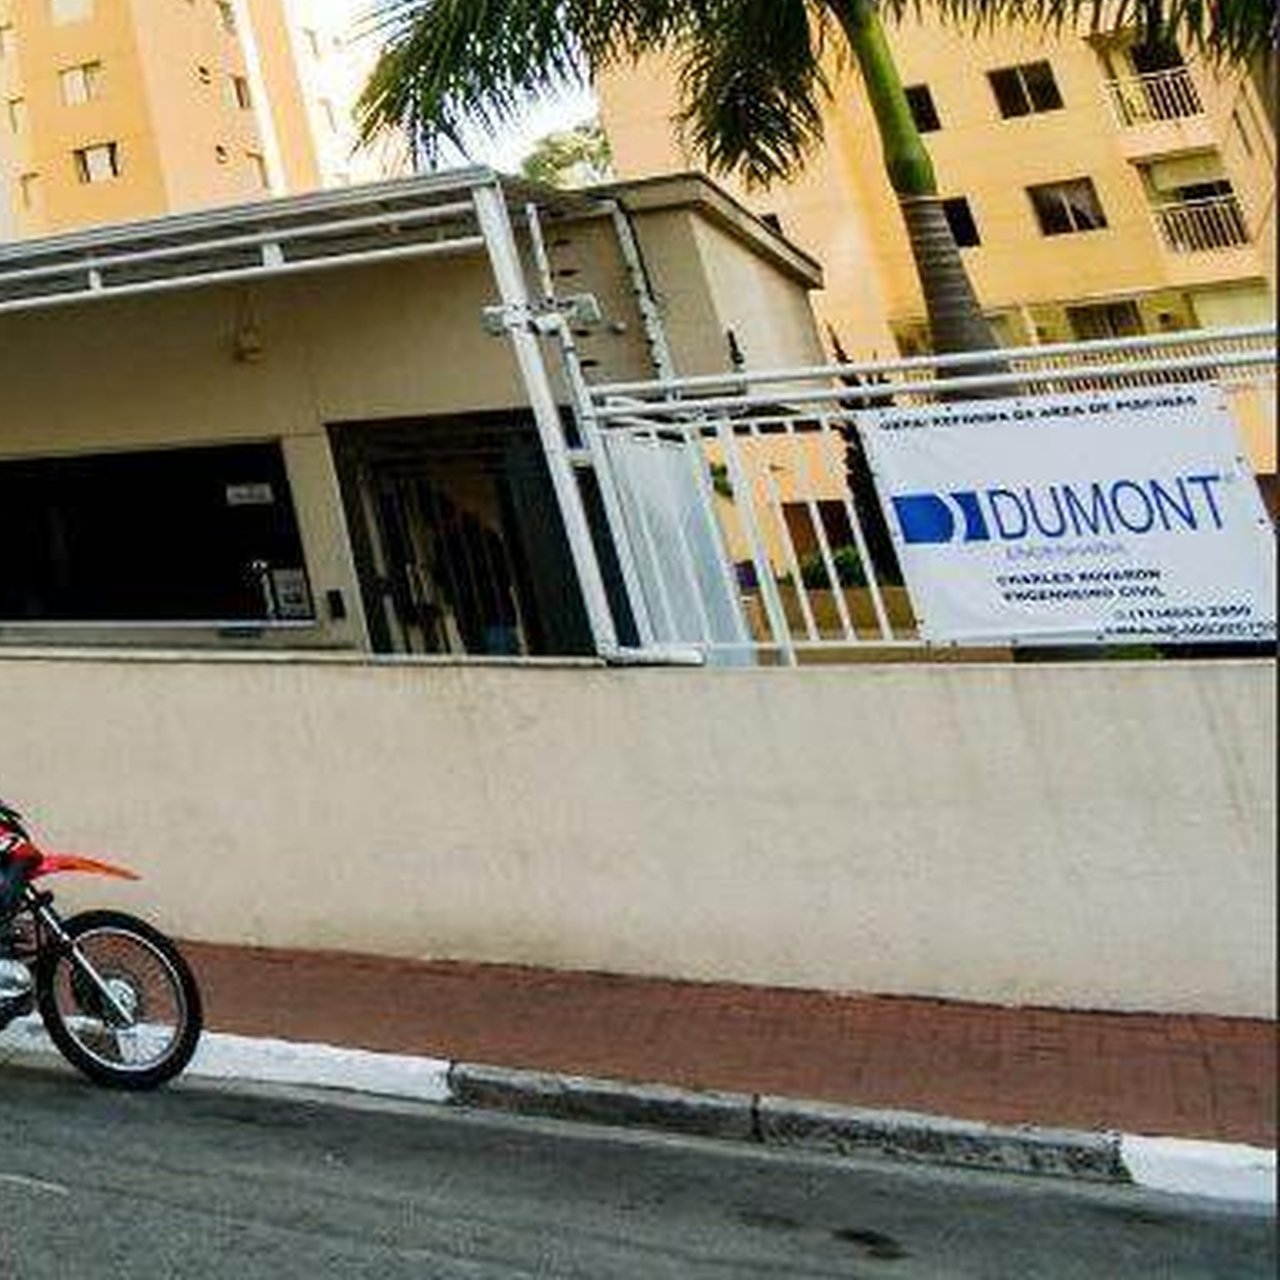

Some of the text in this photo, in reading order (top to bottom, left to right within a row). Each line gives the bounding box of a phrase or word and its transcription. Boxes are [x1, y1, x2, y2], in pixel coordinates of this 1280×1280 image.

[1089, 401, 1110, 414] DE
[987, 475, 1223, 540] DUMONT
[1004, 585, 1166, 602] ENGENHEIRO CIVIL
